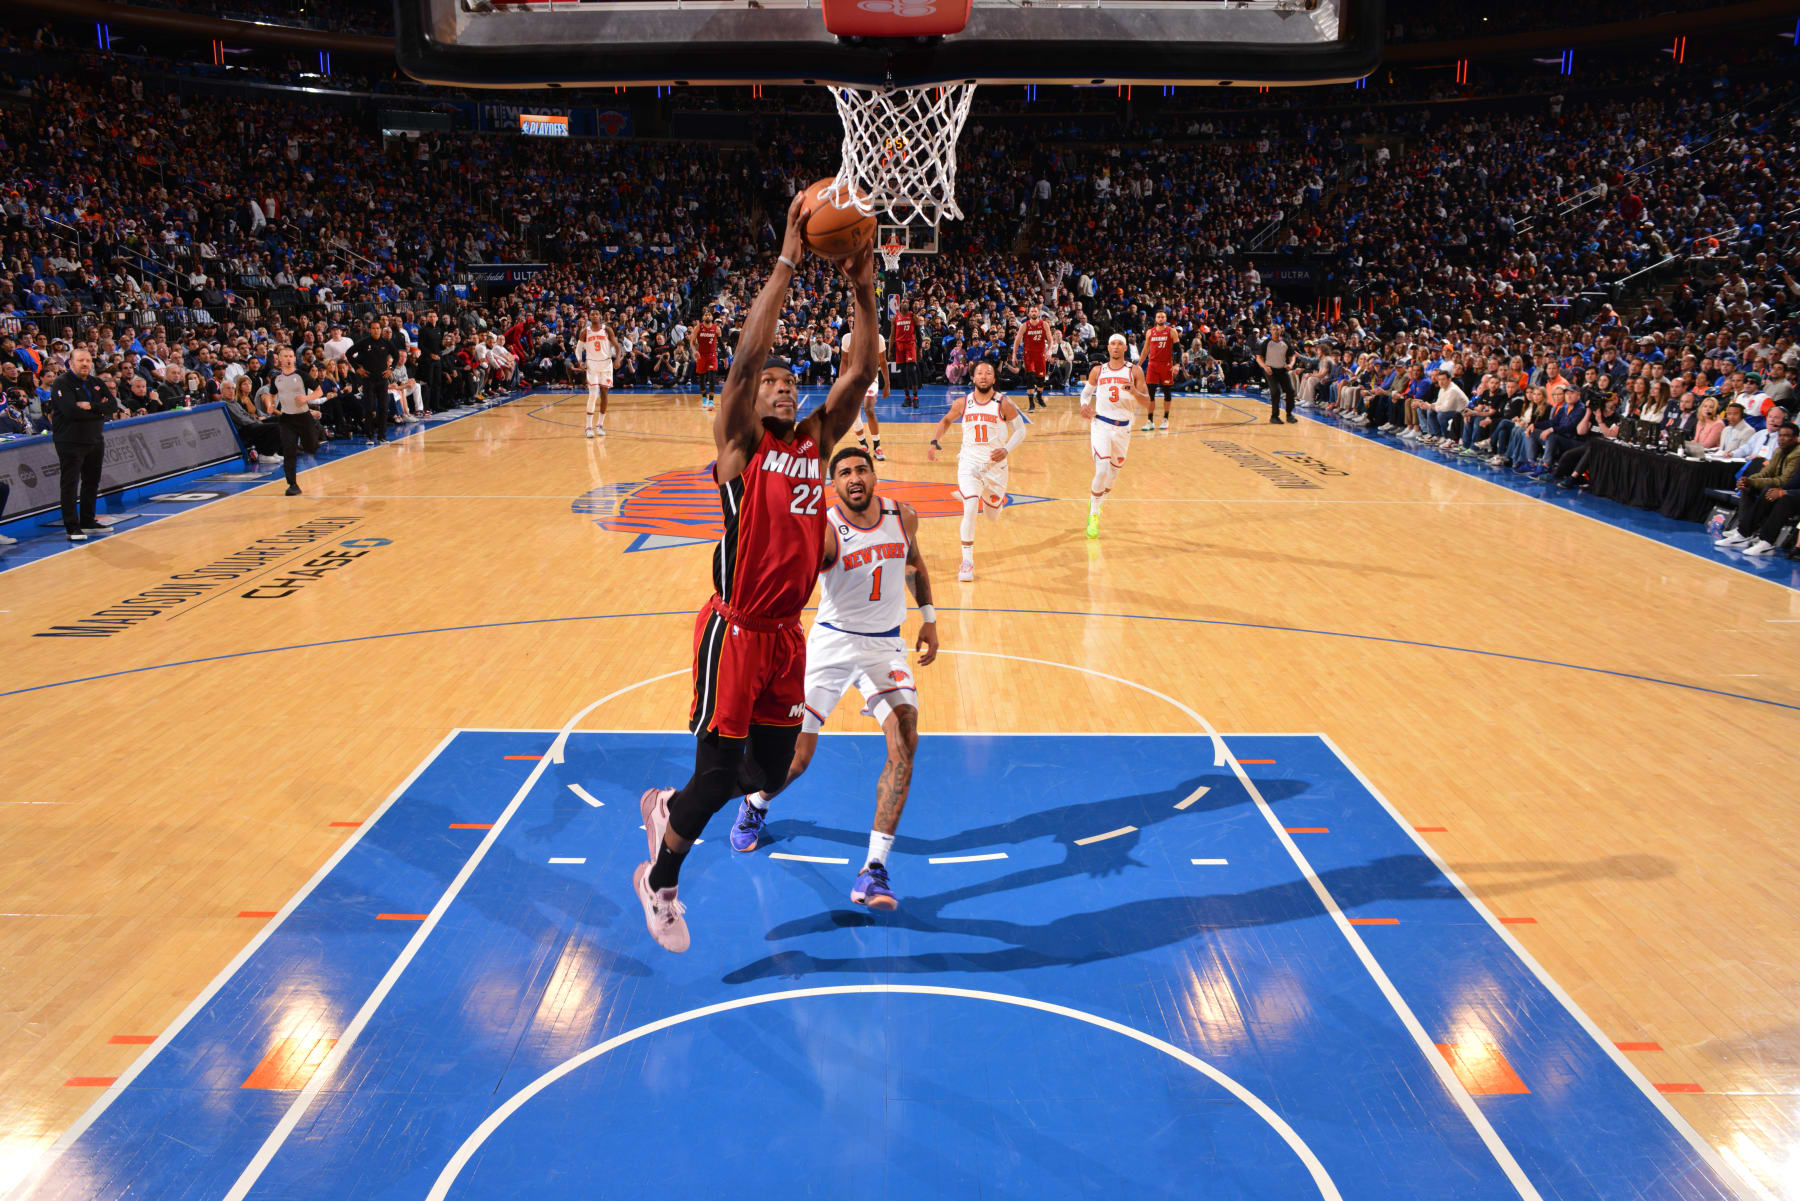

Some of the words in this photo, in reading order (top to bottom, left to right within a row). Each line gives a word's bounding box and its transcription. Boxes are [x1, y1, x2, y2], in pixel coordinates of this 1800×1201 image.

[529, 121, 568, 136] PLAYOFFS
[594, 341, 601, 352] 9
[1158, 341, 1166, 349] 31
[1109, 386, 1120, 403] 3
[975, 424, 989, 443] 11
[790, 484, 823, 515] 22
[842, 546, 873, 572] NEW
[872, 542, 905, 561] YORK
[32, 583, 222, 637] MADISON
[170, 546, 302, 580] SQUARE
[256, 516, 367, 543] GARDEN
[241, 550, 371, 599] CHASE
[868, 565, 883, 602] 1
